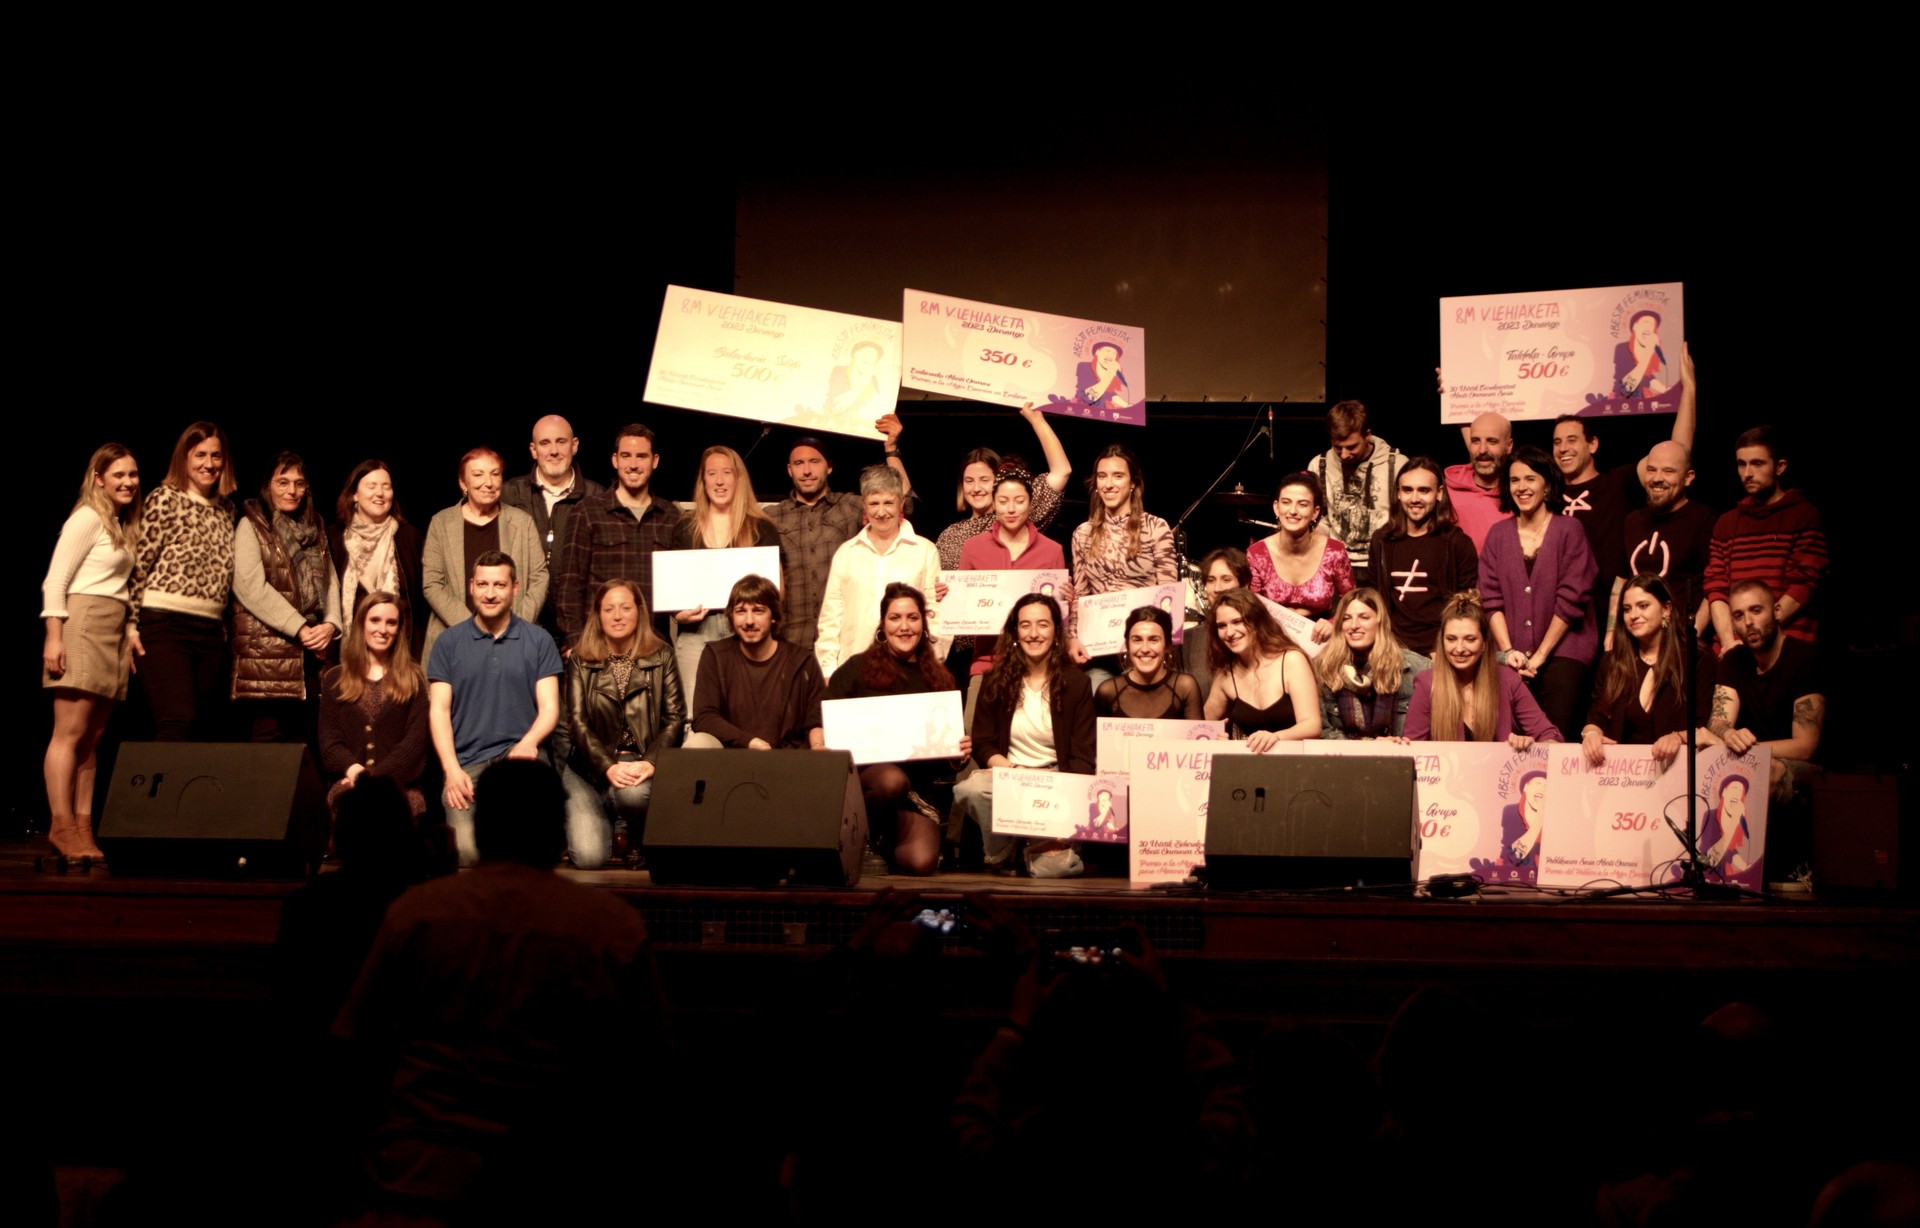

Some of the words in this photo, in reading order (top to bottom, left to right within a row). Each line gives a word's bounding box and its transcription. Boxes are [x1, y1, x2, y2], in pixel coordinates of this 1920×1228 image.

[919, 300, 940, 316] 8M
[1456, 306, 1476, 324] 8M
[721, 320, 745, 332] 2023
[961, 320, 985, 332] 2023
[986, 325, 1026, 339] Durango
[1497, 321, 1521, 332] 2023
[1522, 320, 1561, 331] Durango
[1610, 303, 1624, 339] ABESTI
[1073, 331, 1087, 359] ABESTI
[1547, 345, 1576, 361] Grupo
[980, 348, 1018, 367] 350
[731, 362, 773, 382] 500
[1517, 361, 1558, 379] 500
[977, 598, 994, 608] 150
[1108, 619, 1122, 629] 150
[1147, 751, 1169, 771] 8M
[1560, 757, 1579, 776] 8M
[1194, 771, 1210, 781] 20
[1417, 775, 1441, 785] ango
[1498, 760, 1514, 800] ABESTI
[1511, 747, 1549, 767] FEMINIS
[1701, 764, 1716, 798] BESTI
[1598, 777, 1619, 786] 2023
[1621, 777, 1656, 789] Durango
[1031, 799, 1050, 809] 150
[1426, 802, 1458, 820] Grupo
[1611, 812, 1647, 831] 350
